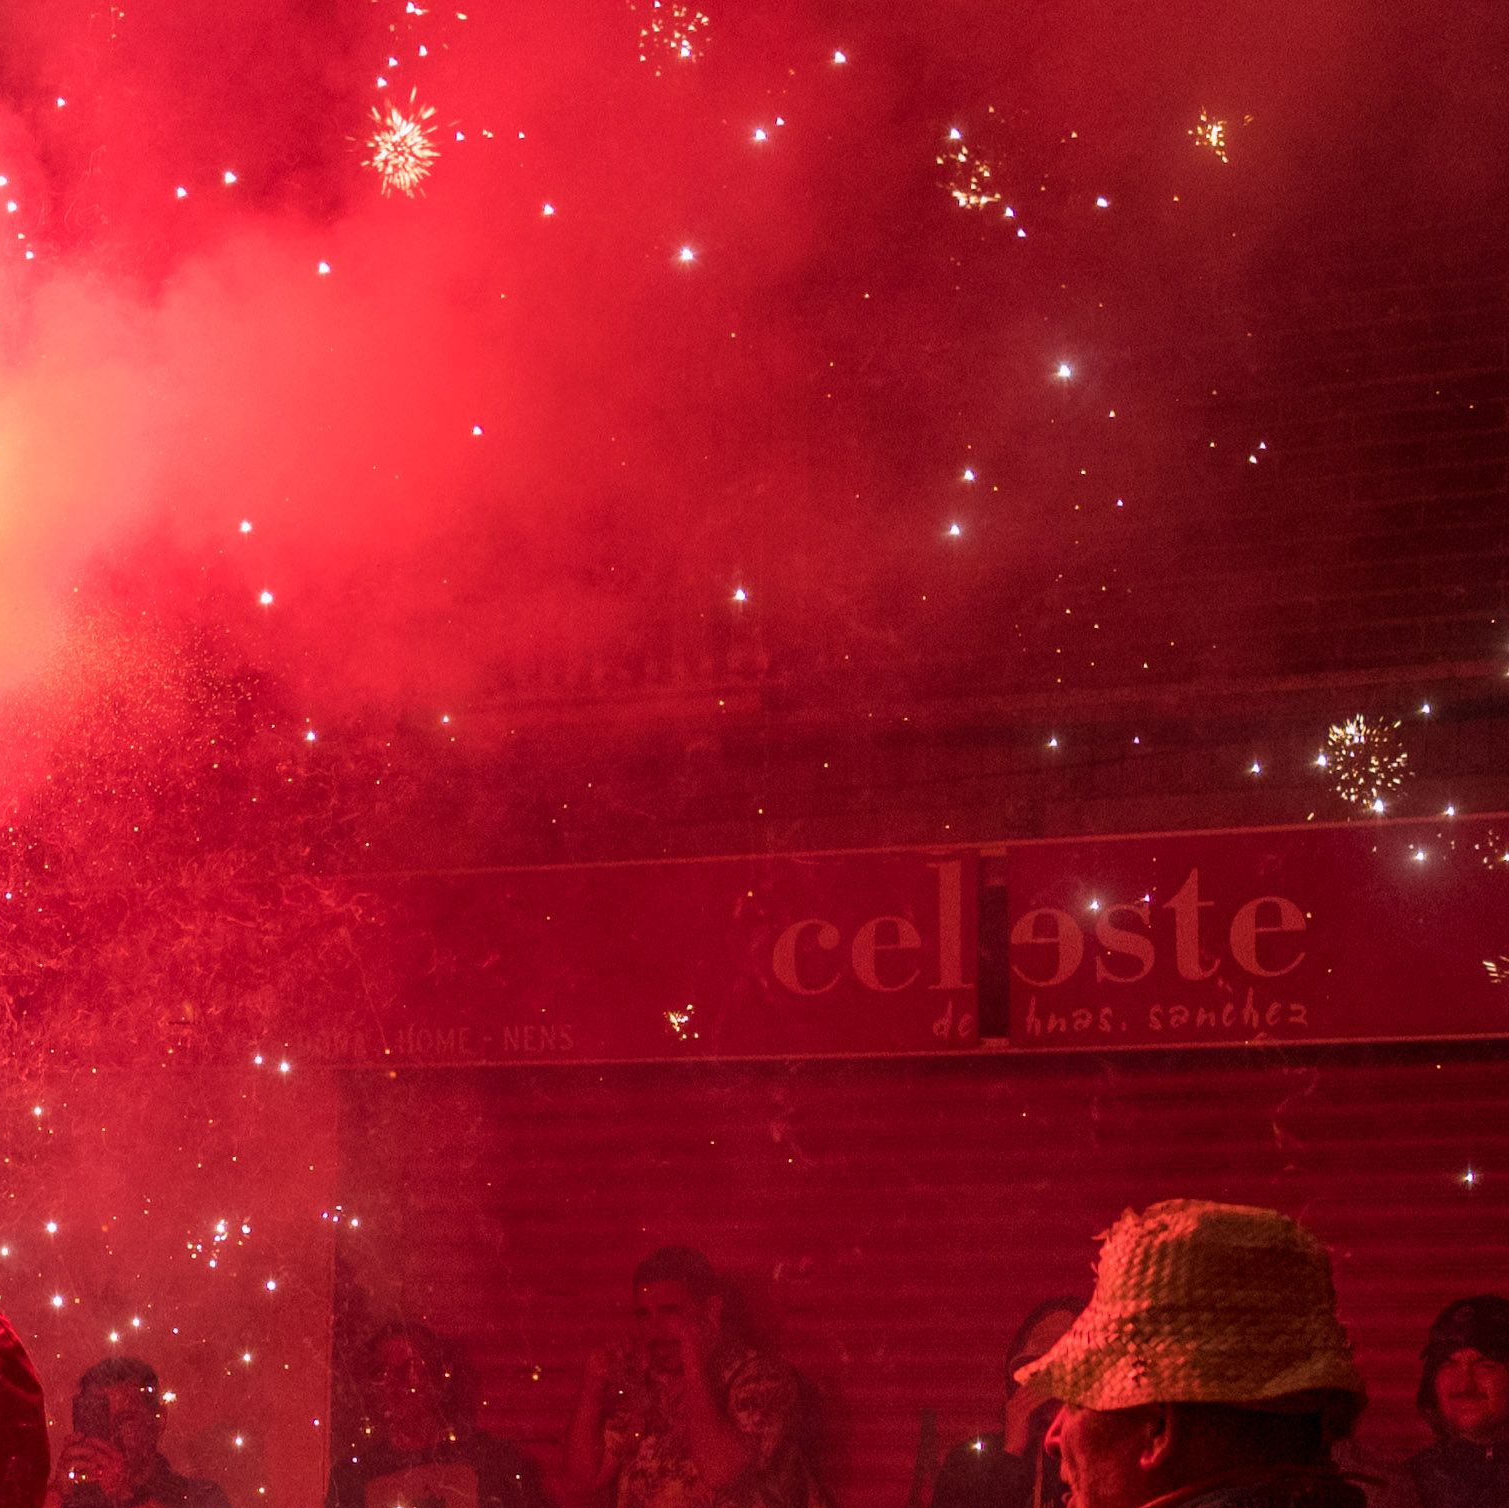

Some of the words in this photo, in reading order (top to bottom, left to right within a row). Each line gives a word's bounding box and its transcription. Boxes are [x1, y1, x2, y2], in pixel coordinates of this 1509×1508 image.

[932, 998, 974, 1040] de
[1148, 986, 1308, 1031] sanchez
[397, 1025, 472, 1053] HOME
[502, 1024, 575, 1052] NENS
